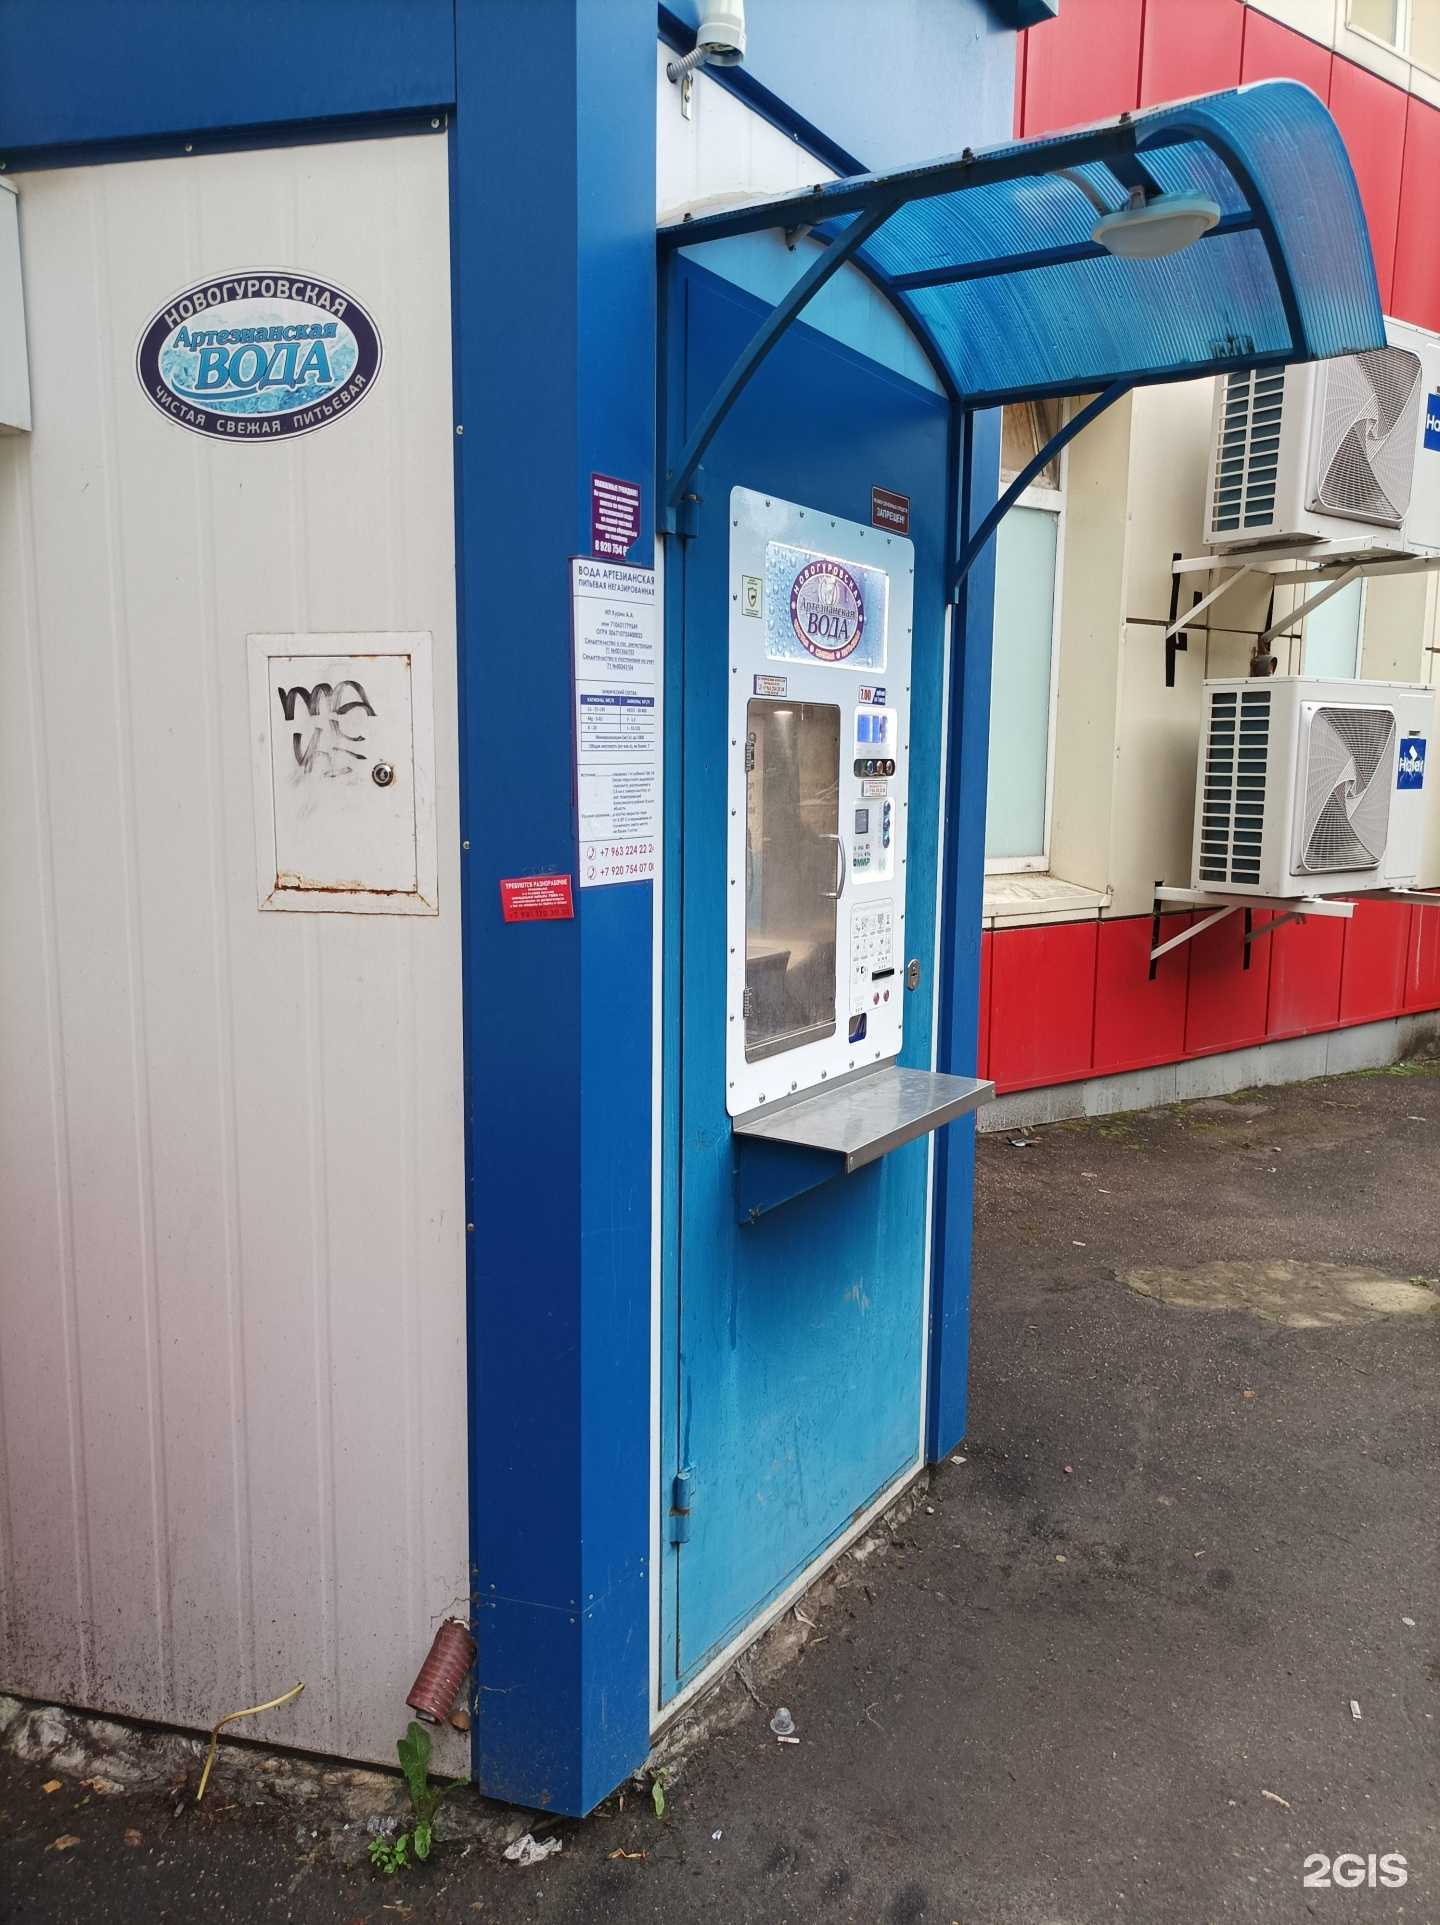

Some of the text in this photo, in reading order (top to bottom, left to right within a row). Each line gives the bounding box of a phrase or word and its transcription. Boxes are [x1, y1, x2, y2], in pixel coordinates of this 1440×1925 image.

[164, 279, 348, 328] НОВОГУРОВСКАЯ
[173, 322, 338, 351] Артезианская
[194, 340, 333, 391] ВОДА
[155, 374, 366, 434] ЧИСТАЯ СВЕЖАЯ ПИТЬЕВАЯ
[578, 566, 655, 585] ВОДА АРТЕЗИАНСКАЯ
[578, 579, 655, 596] ПИТЬЕВАЯ НЕГАЗИРОВАННАЯ
[793, 563, 863, 608] НОВОГУРОВСКАЯ
[808, 612, 848, 639] ВОДА
[600, 848, 609, 857] +7
[611, 846, 624, 856] 963
[625, 844, 638, 856] 224
[639, 844, 648, 854] 22
[600, 867, 609, 877] +7
[611, 865, 624, 876] 920
[625, 863, 638, 874] 754
[640, 863, 647, 873] 07
